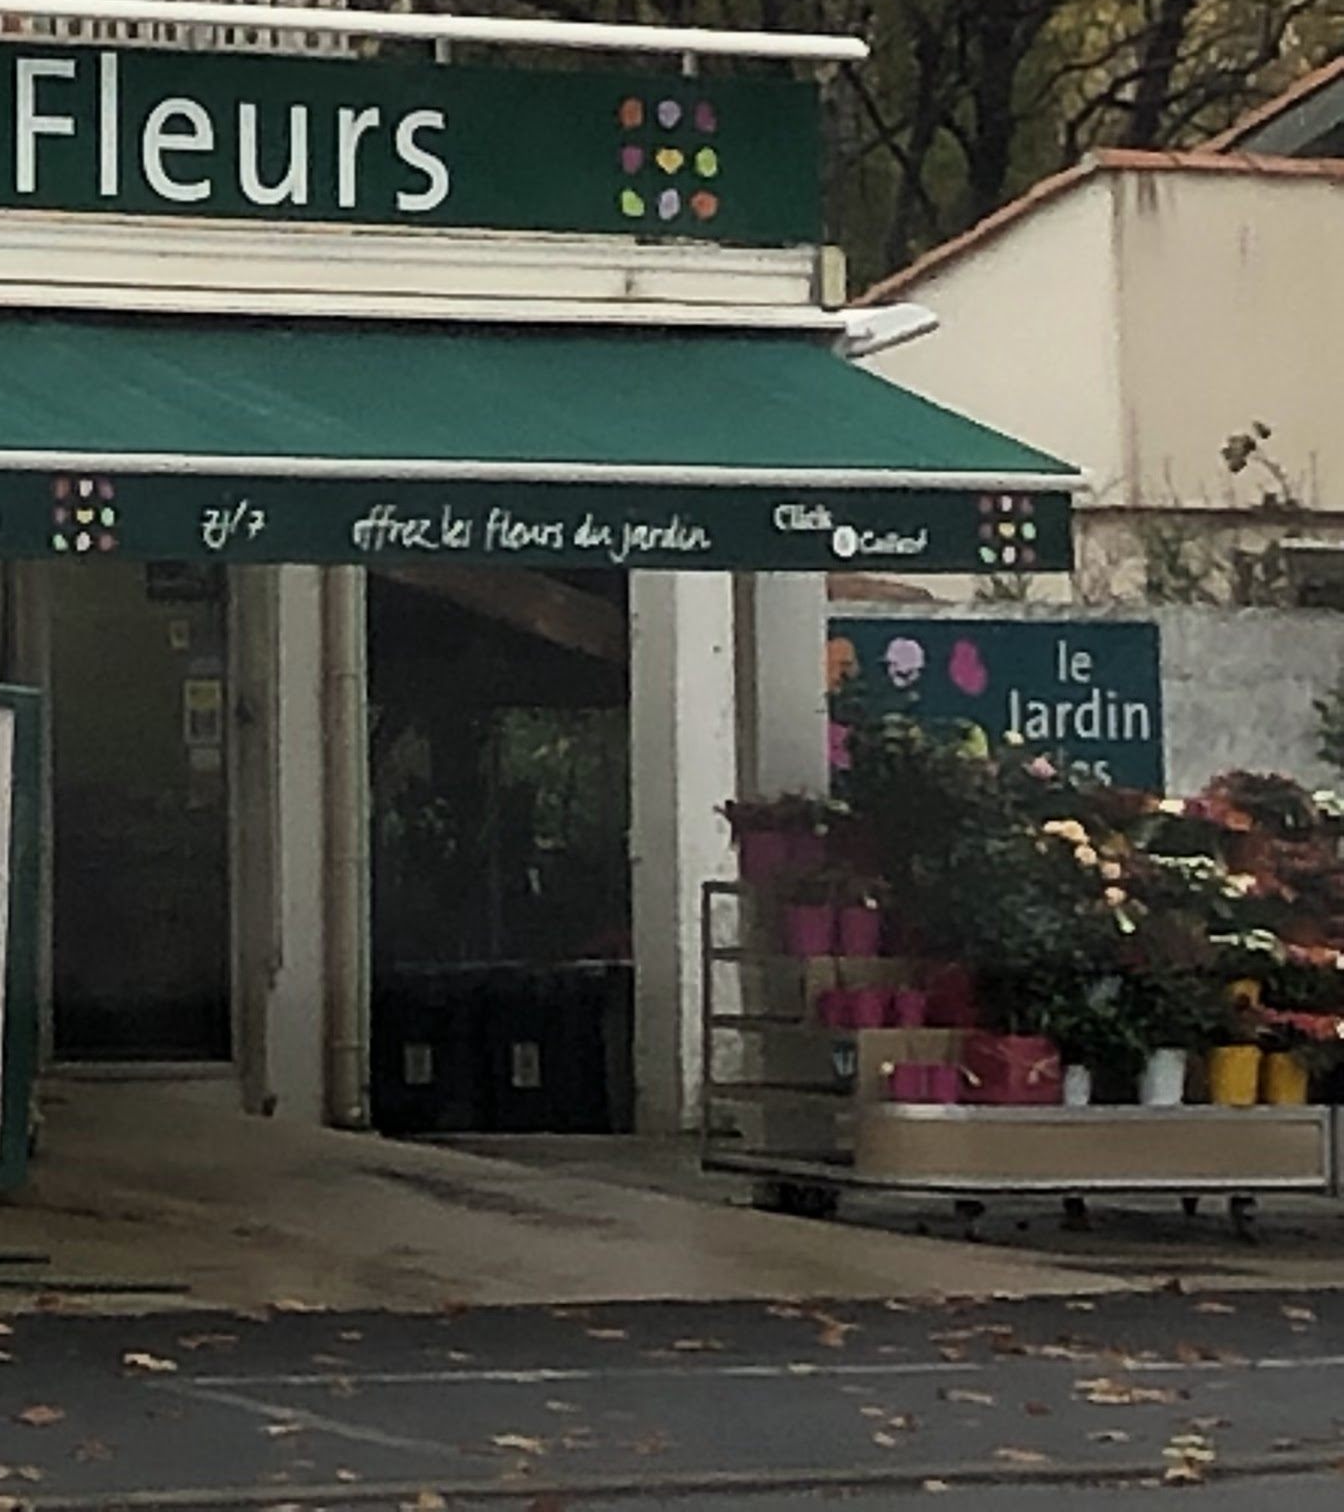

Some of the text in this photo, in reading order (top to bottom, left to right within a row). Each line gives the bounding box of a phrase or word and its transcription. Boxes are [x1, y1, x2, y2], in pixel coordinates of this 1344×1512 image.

[16, 51, 450, 212] Fleurs
[440, 504, 474, 549] les
[572, 512, 613, 550] du
[610, 514, 712, 564] jardin
[1056, 639, 1093, 684] le
[1056, 745, 1112, 787] es
